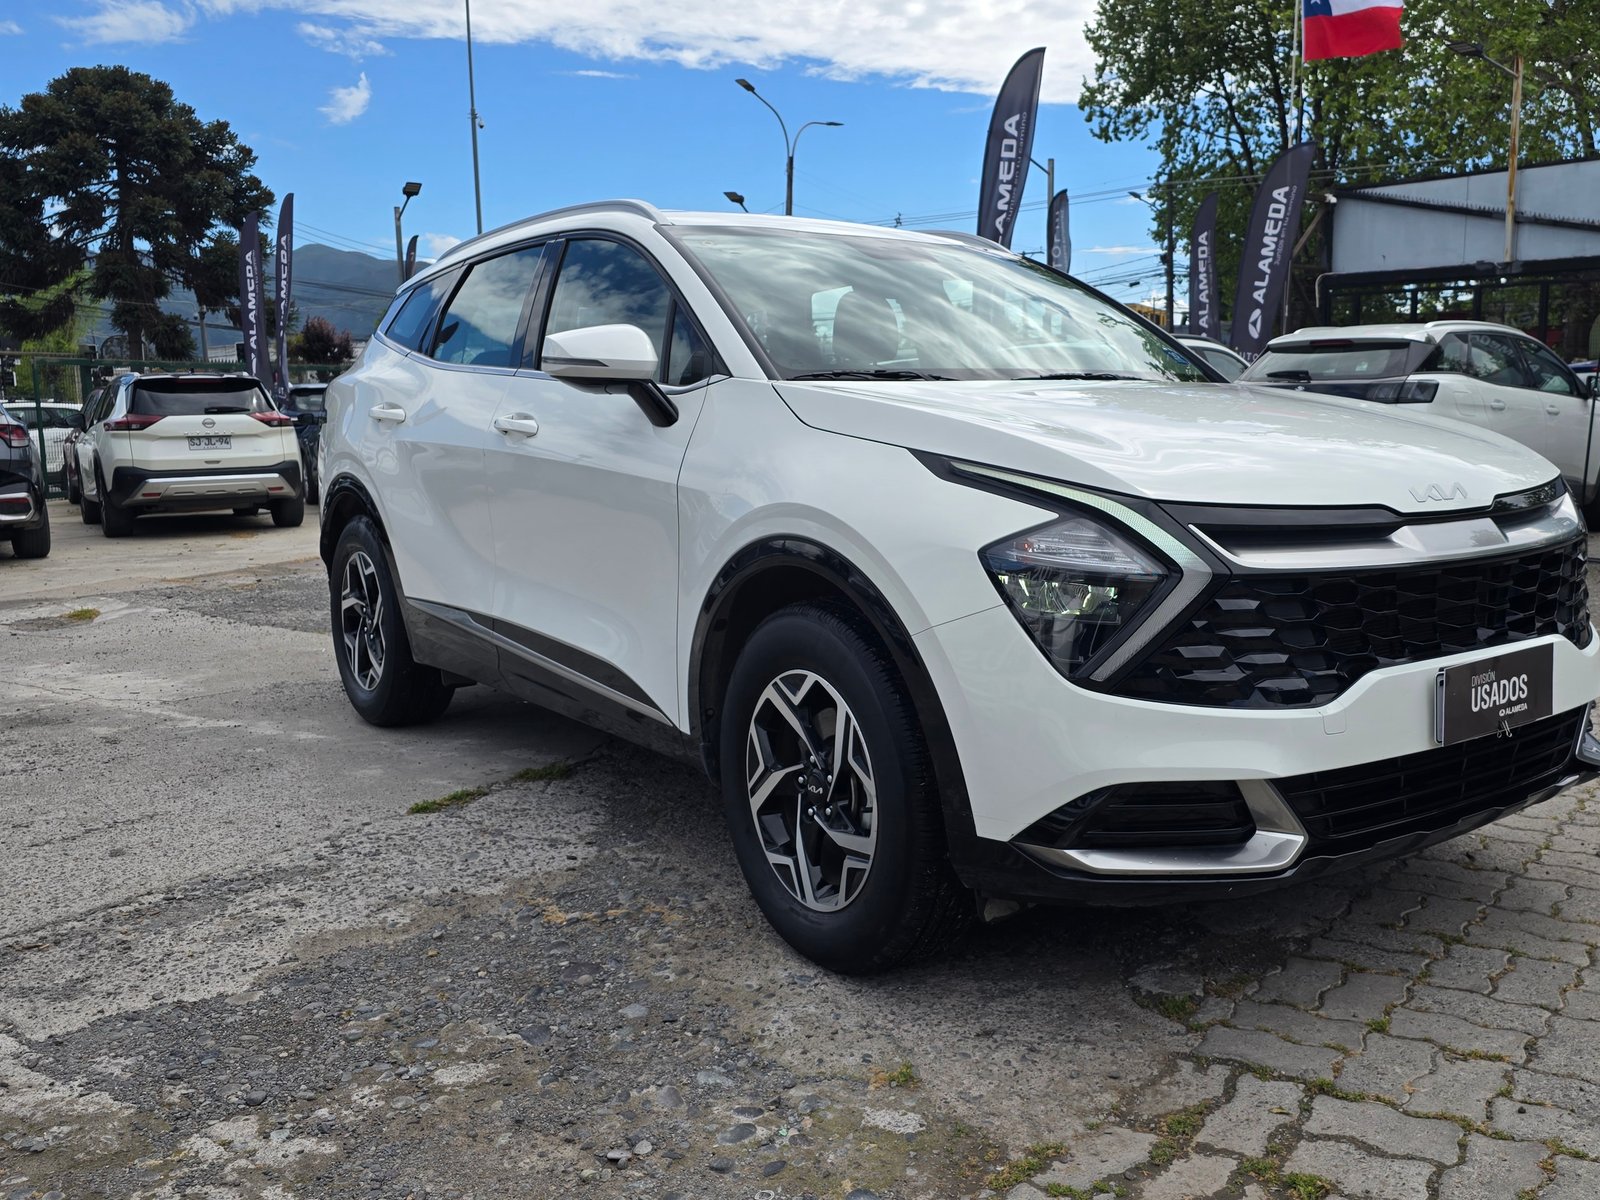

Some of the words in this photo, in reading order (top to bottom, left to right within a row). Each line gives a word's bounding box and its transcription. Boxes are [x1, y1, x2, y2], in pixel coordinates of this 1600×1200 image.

[994, 113, 1020, 244] AMEDA
[1197, 231, 1210, 328] ALAMEDA
[1252, 185, 1290, 304] ALAMEDA
[245, 250, 257, 350] ALAMEDA
[1471, 669, 1496, 687] DIVISIÓN
[1471, 673, 1528, 712] USADOS
[1505, 702, 1528, 715] ALAMEDA
